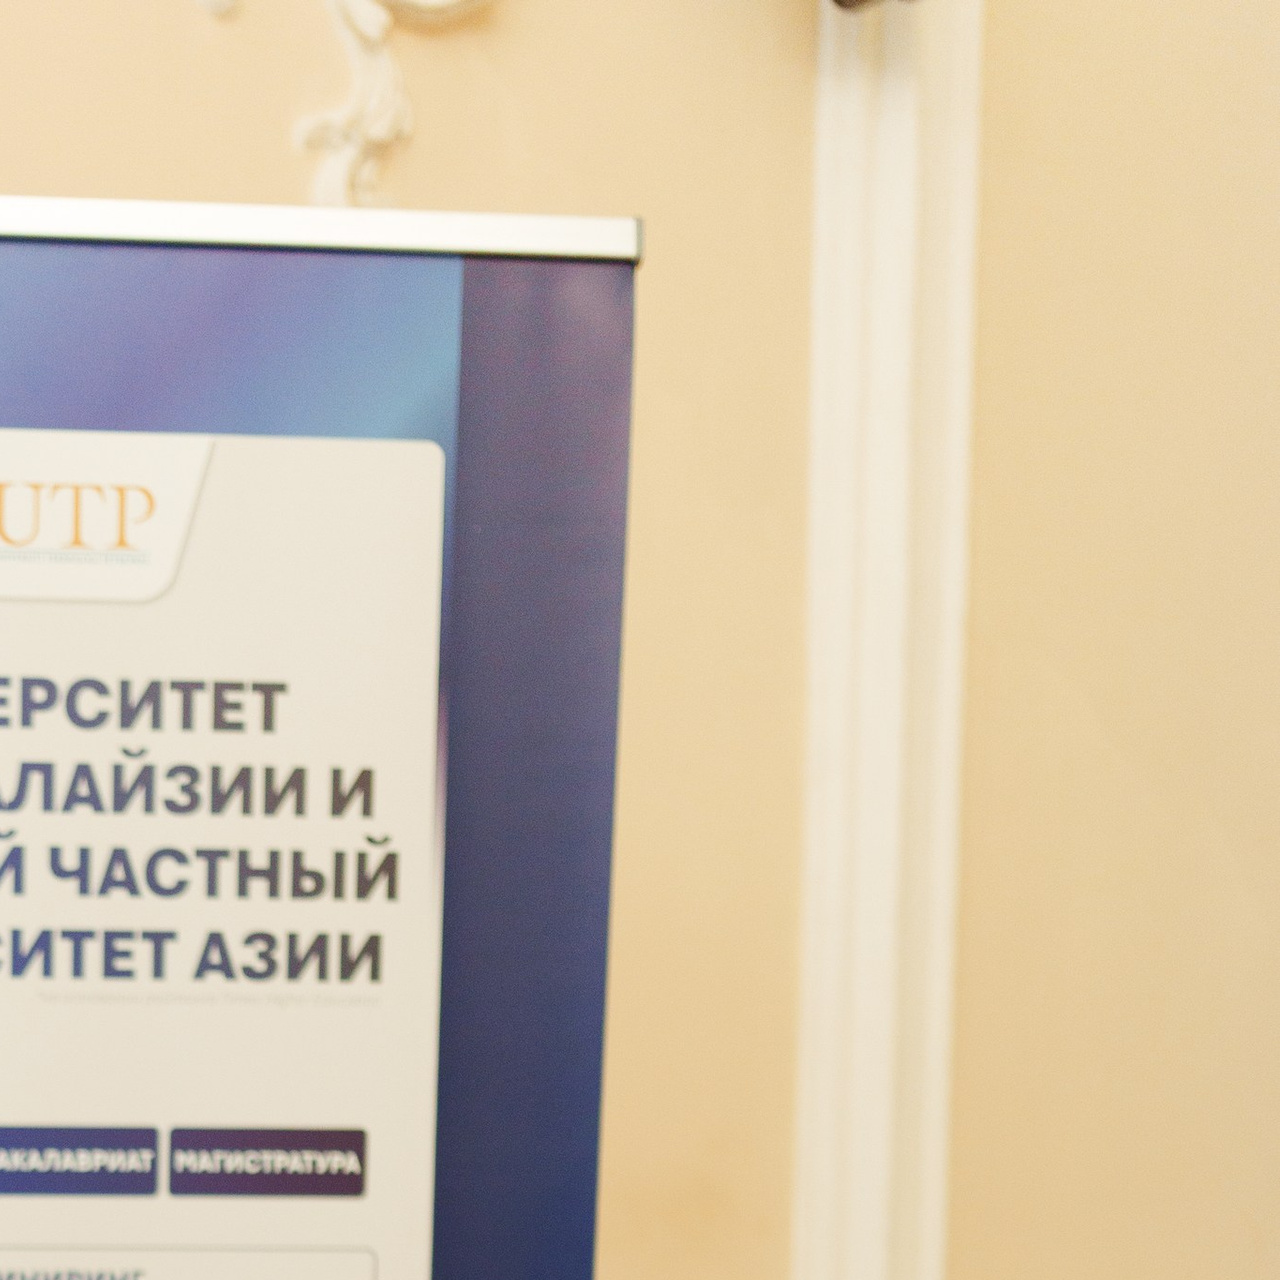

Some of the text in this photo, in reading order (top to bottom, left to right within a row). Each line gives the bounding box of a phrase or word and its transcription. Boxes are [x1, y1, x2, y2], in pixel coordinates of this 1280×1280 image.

[330, 768, 377, 818] И
[49, 836, 401, 902] ЧАСТНЫЙ
[193, 932, 384, 984] АЗИИ
[172, 1149, 363, 1176] МАГИСТРАТУРА
